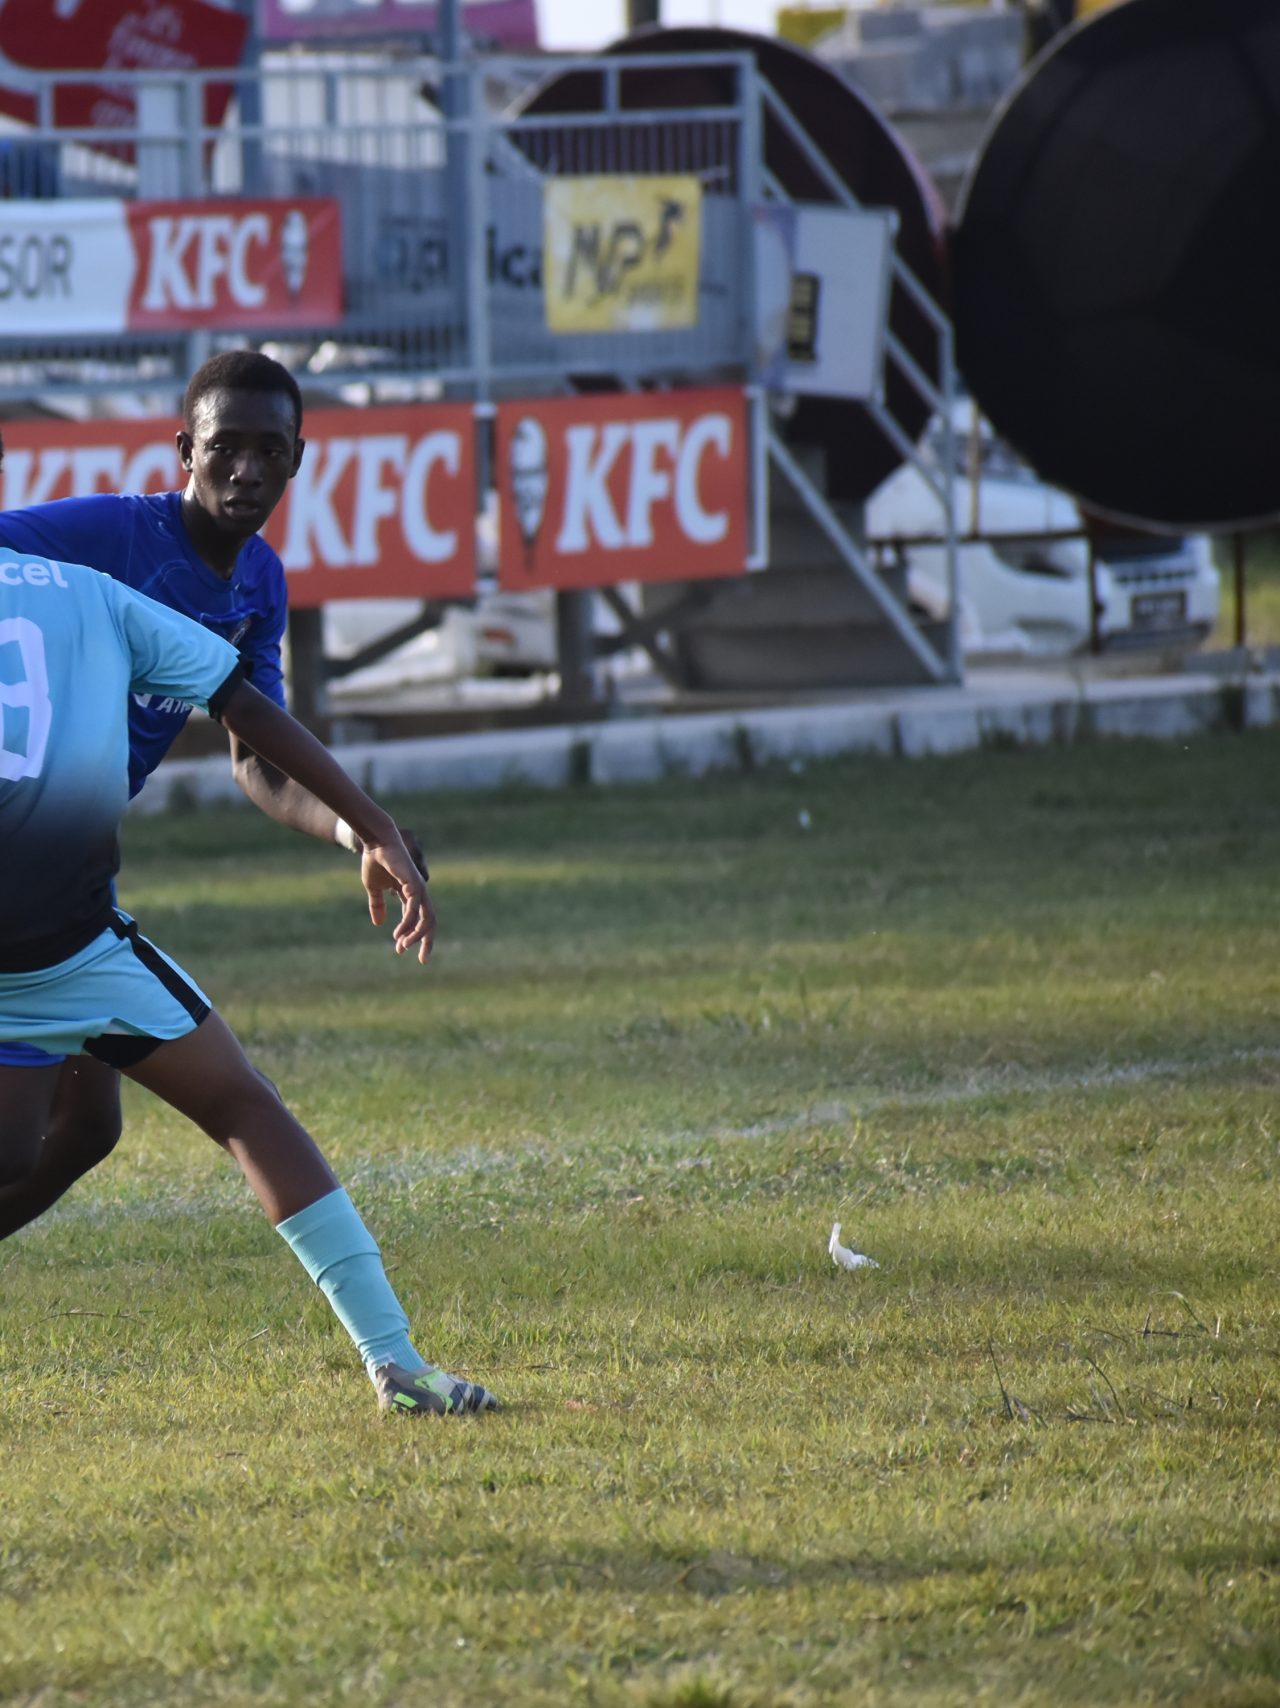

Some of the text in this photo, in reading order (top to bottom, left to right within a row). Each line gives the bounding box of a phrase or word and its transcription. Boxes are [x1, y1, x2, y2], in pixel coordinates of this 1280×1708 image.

[142, 212, 270, 311] KFC
[283, 429, 462, 570] KFC
[556, 412, 732, 554] KFC
